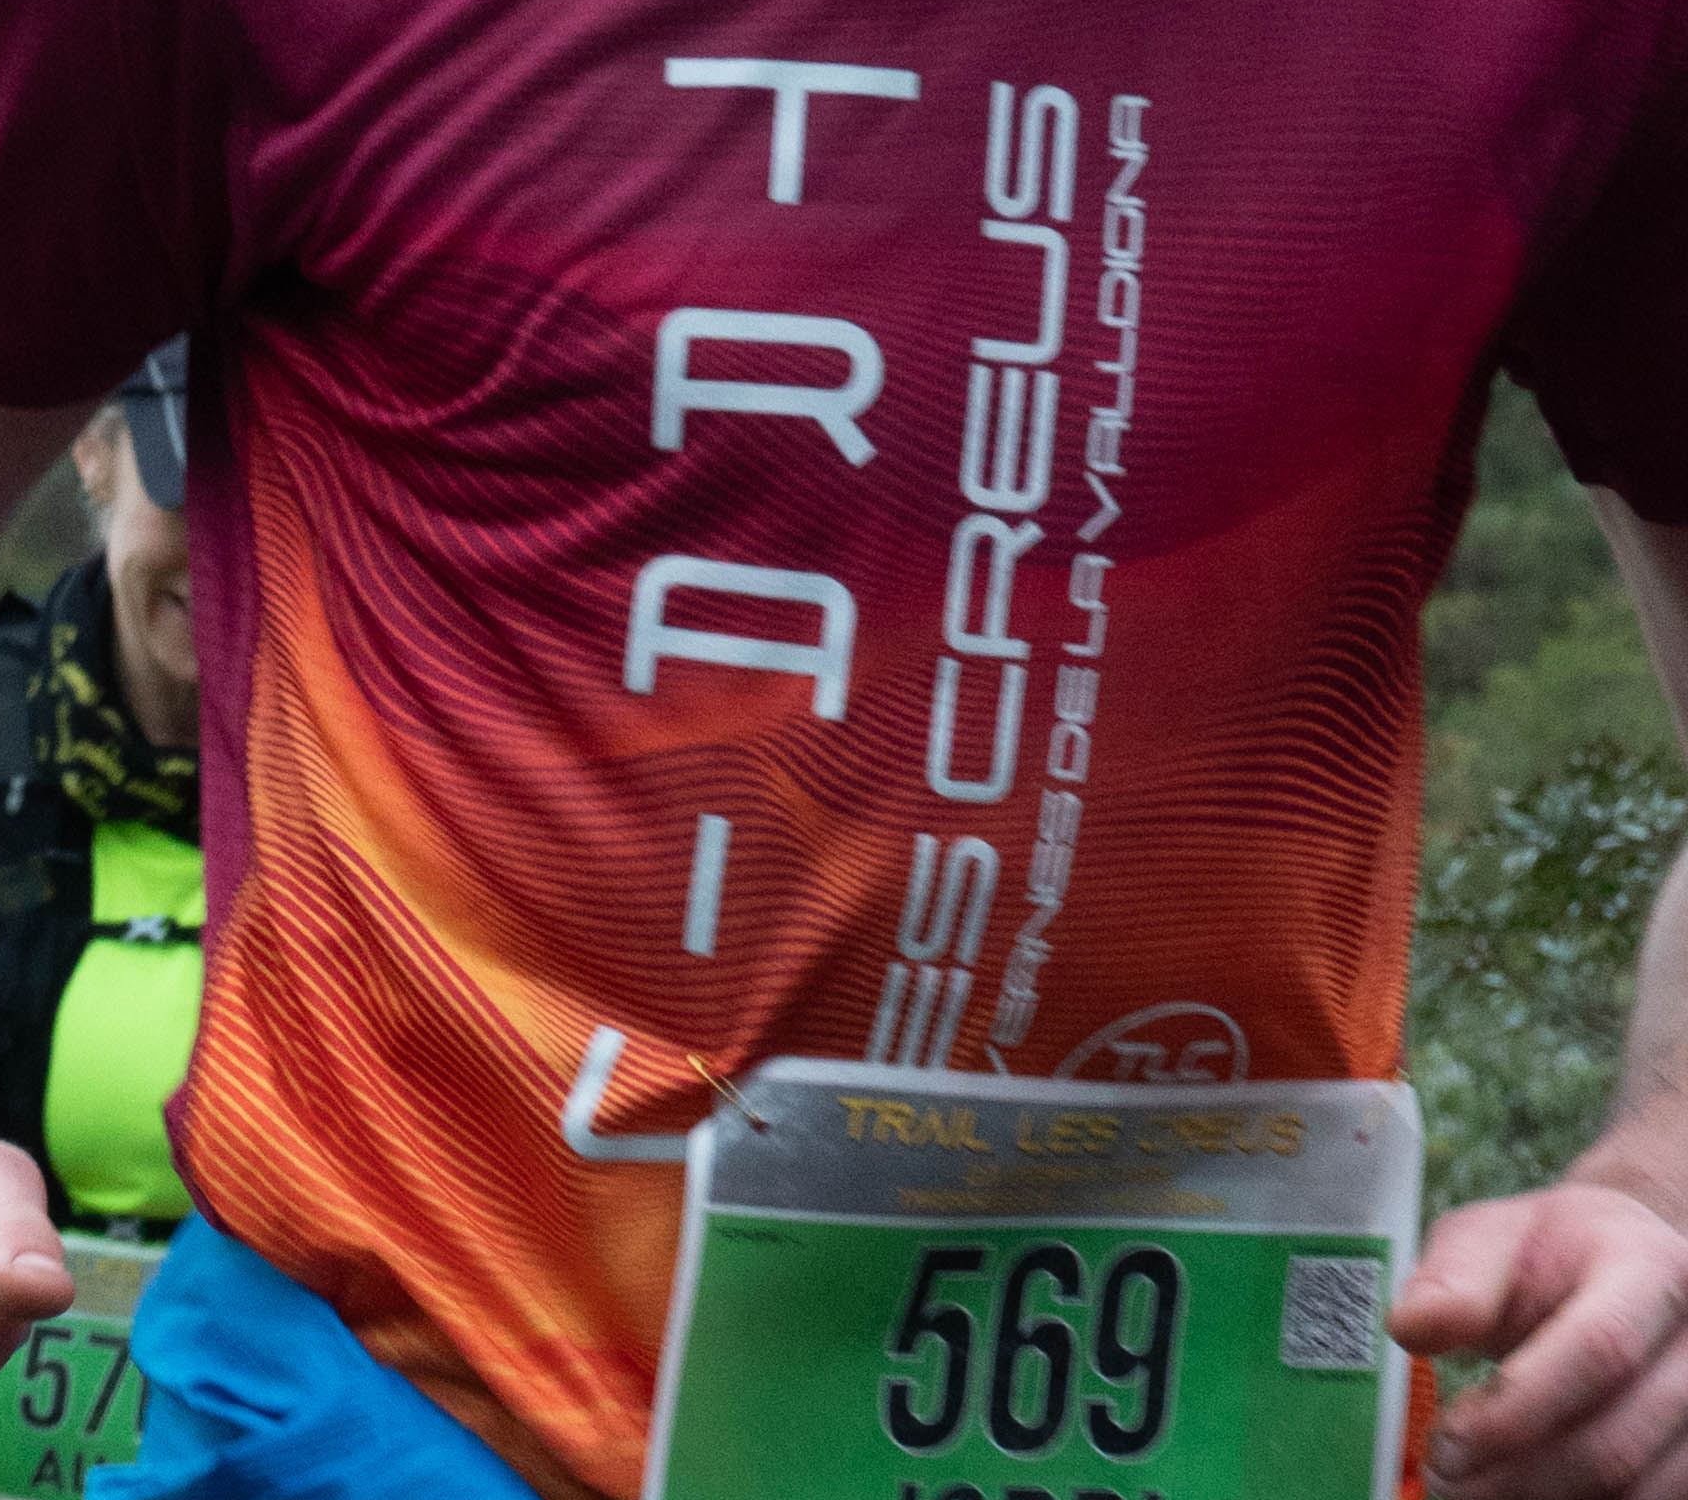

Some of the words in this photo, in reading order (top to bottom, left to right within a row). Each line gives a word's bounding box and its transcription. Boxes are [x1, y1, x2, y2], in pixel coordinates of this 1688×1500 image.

[1076, 94, 1153, 543] VALLDIGNA
[925, 82, 1079, 804] CREUS
[562, 57, 921, 1163] TRAIL
[1061, 553, 1116, 657] LA
[1046, 664, 1101, 783] DE
[838, 1096, 991, 1152] TRAIL
[1017, 1108, 1121, 1155] LES
[19, 1324, 151, 1437] 57
[883, 1240, 1185, 1460] 569
